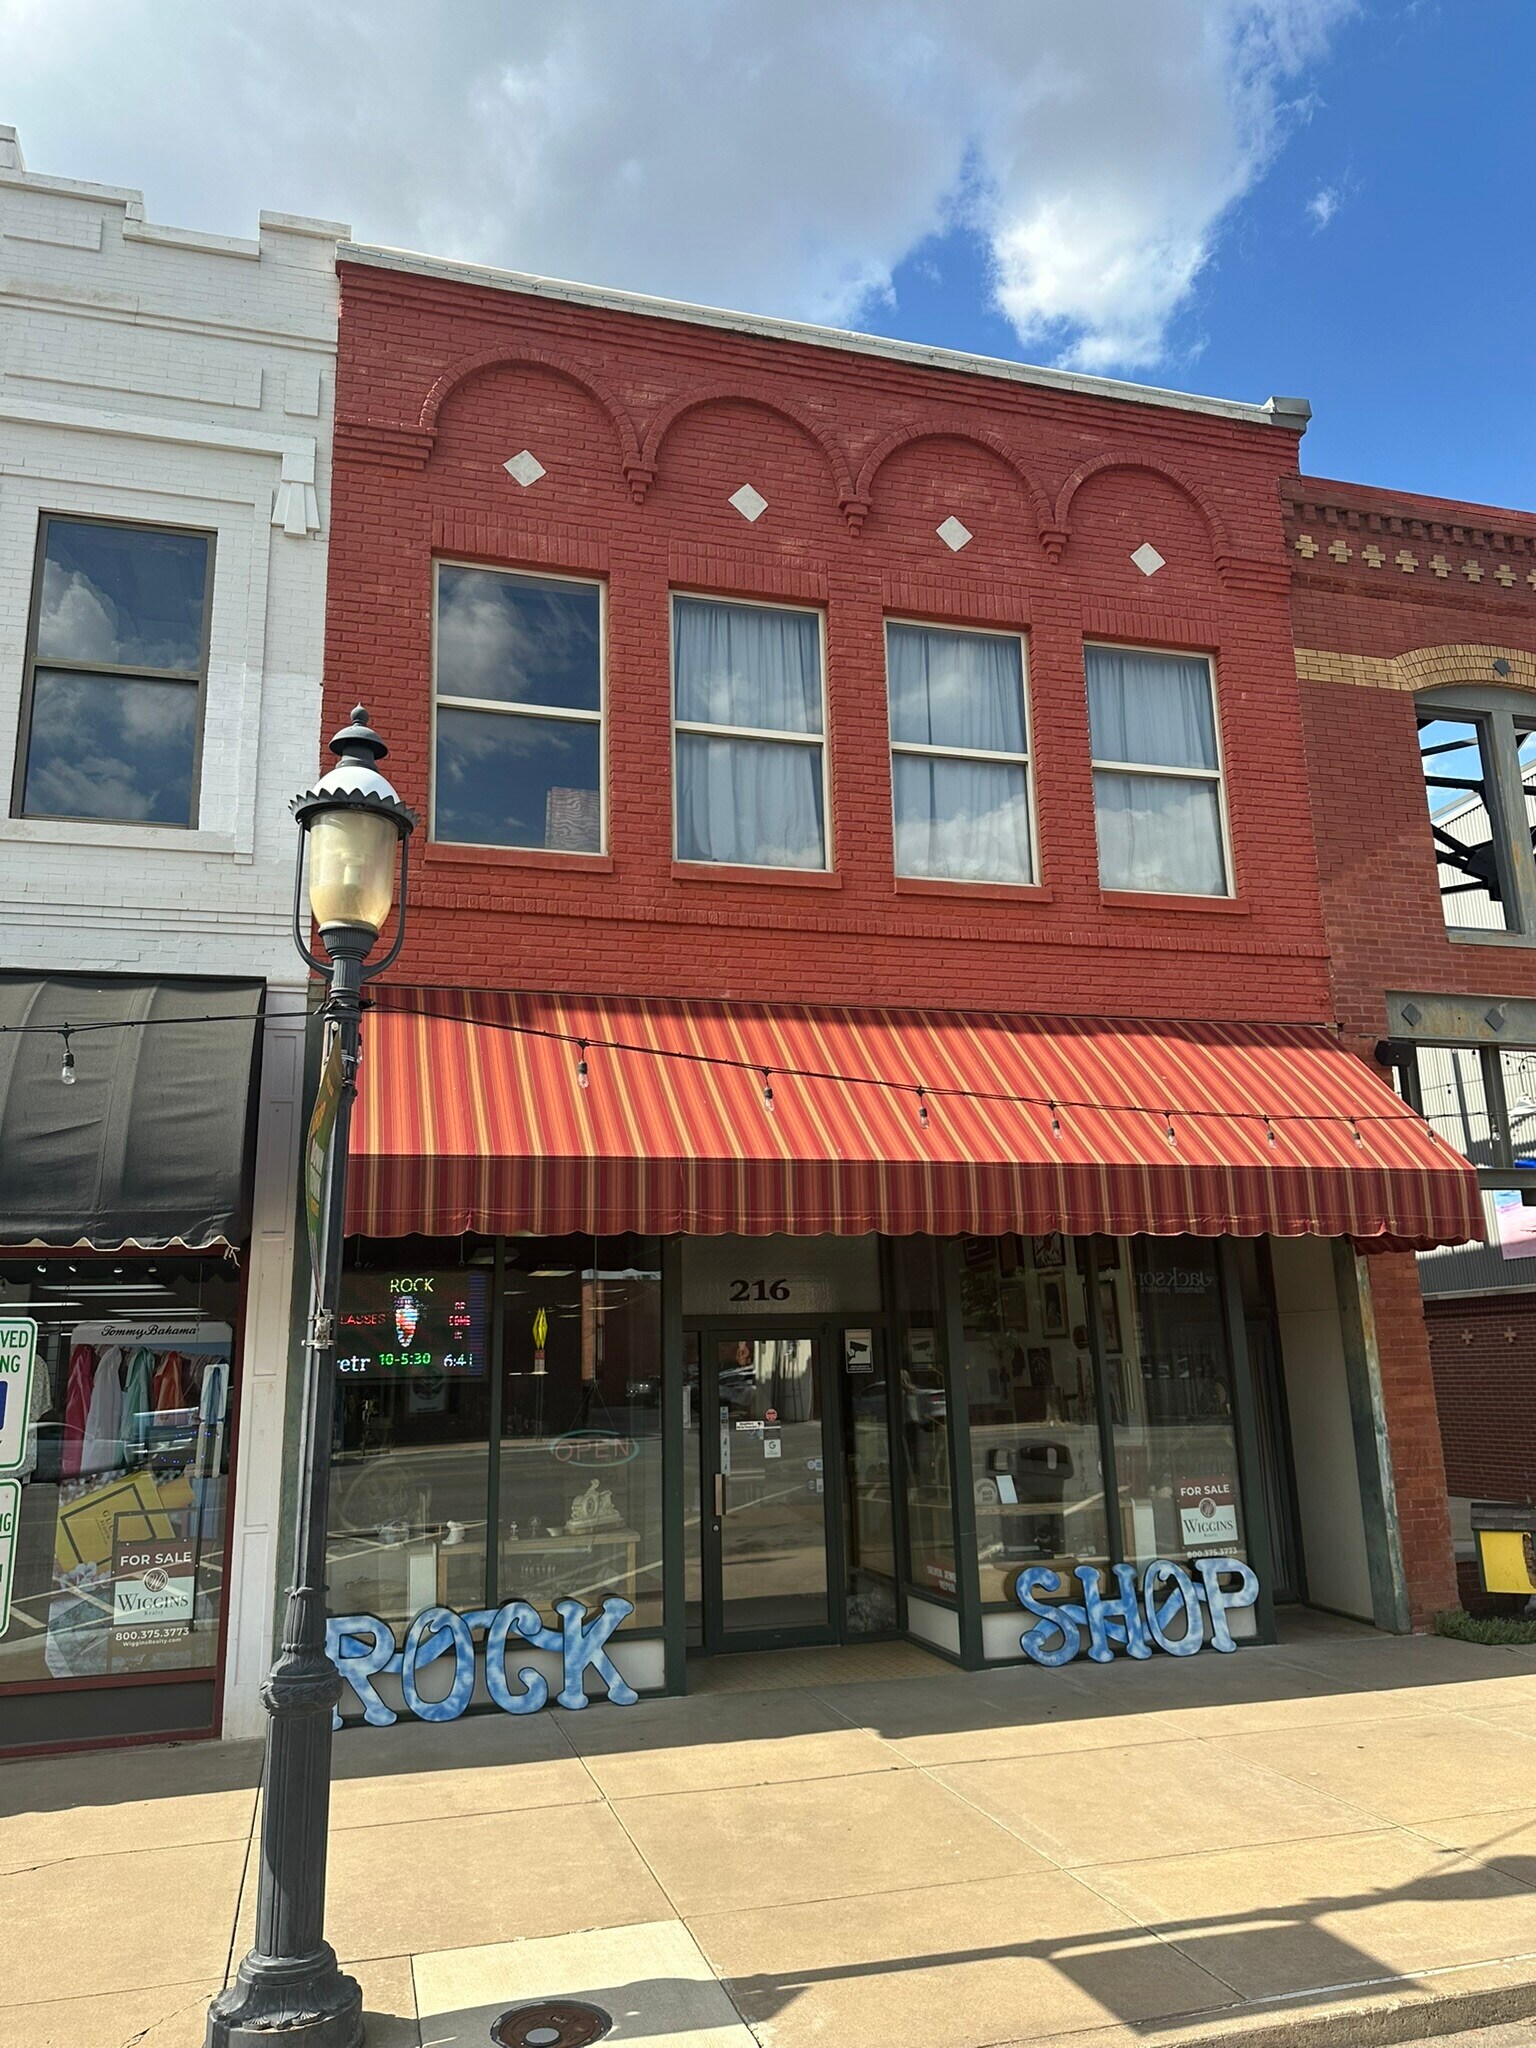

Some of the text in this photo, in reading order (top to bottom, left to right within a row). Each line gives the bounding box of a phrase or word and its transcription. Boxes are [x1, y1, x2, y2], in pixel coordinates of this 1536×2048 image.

[389, 1278, 434, 1293] ROCK
[730, 1279, 790, 1301] 216
[101, 1324, 198, 1340] Tommy Bahama
[379, 1352, 431, 1366] 10-5:30
[555, 1437, 630, 1462] OPEN
[1180, 1484, 1230, 1497] FOR SALE
[120, 1551, 192, 1567] FOR SALE
[1186, 1546, 1238, 1559] 800.375.3773
[1015, 1557, 1260, 1668] SHOP
[115, 1627, 189, 1641] 800.375.3773
[122, 1638, 182, 1647] WigginsRealty.com
[323, 1596, 639, 1732] ROCK
